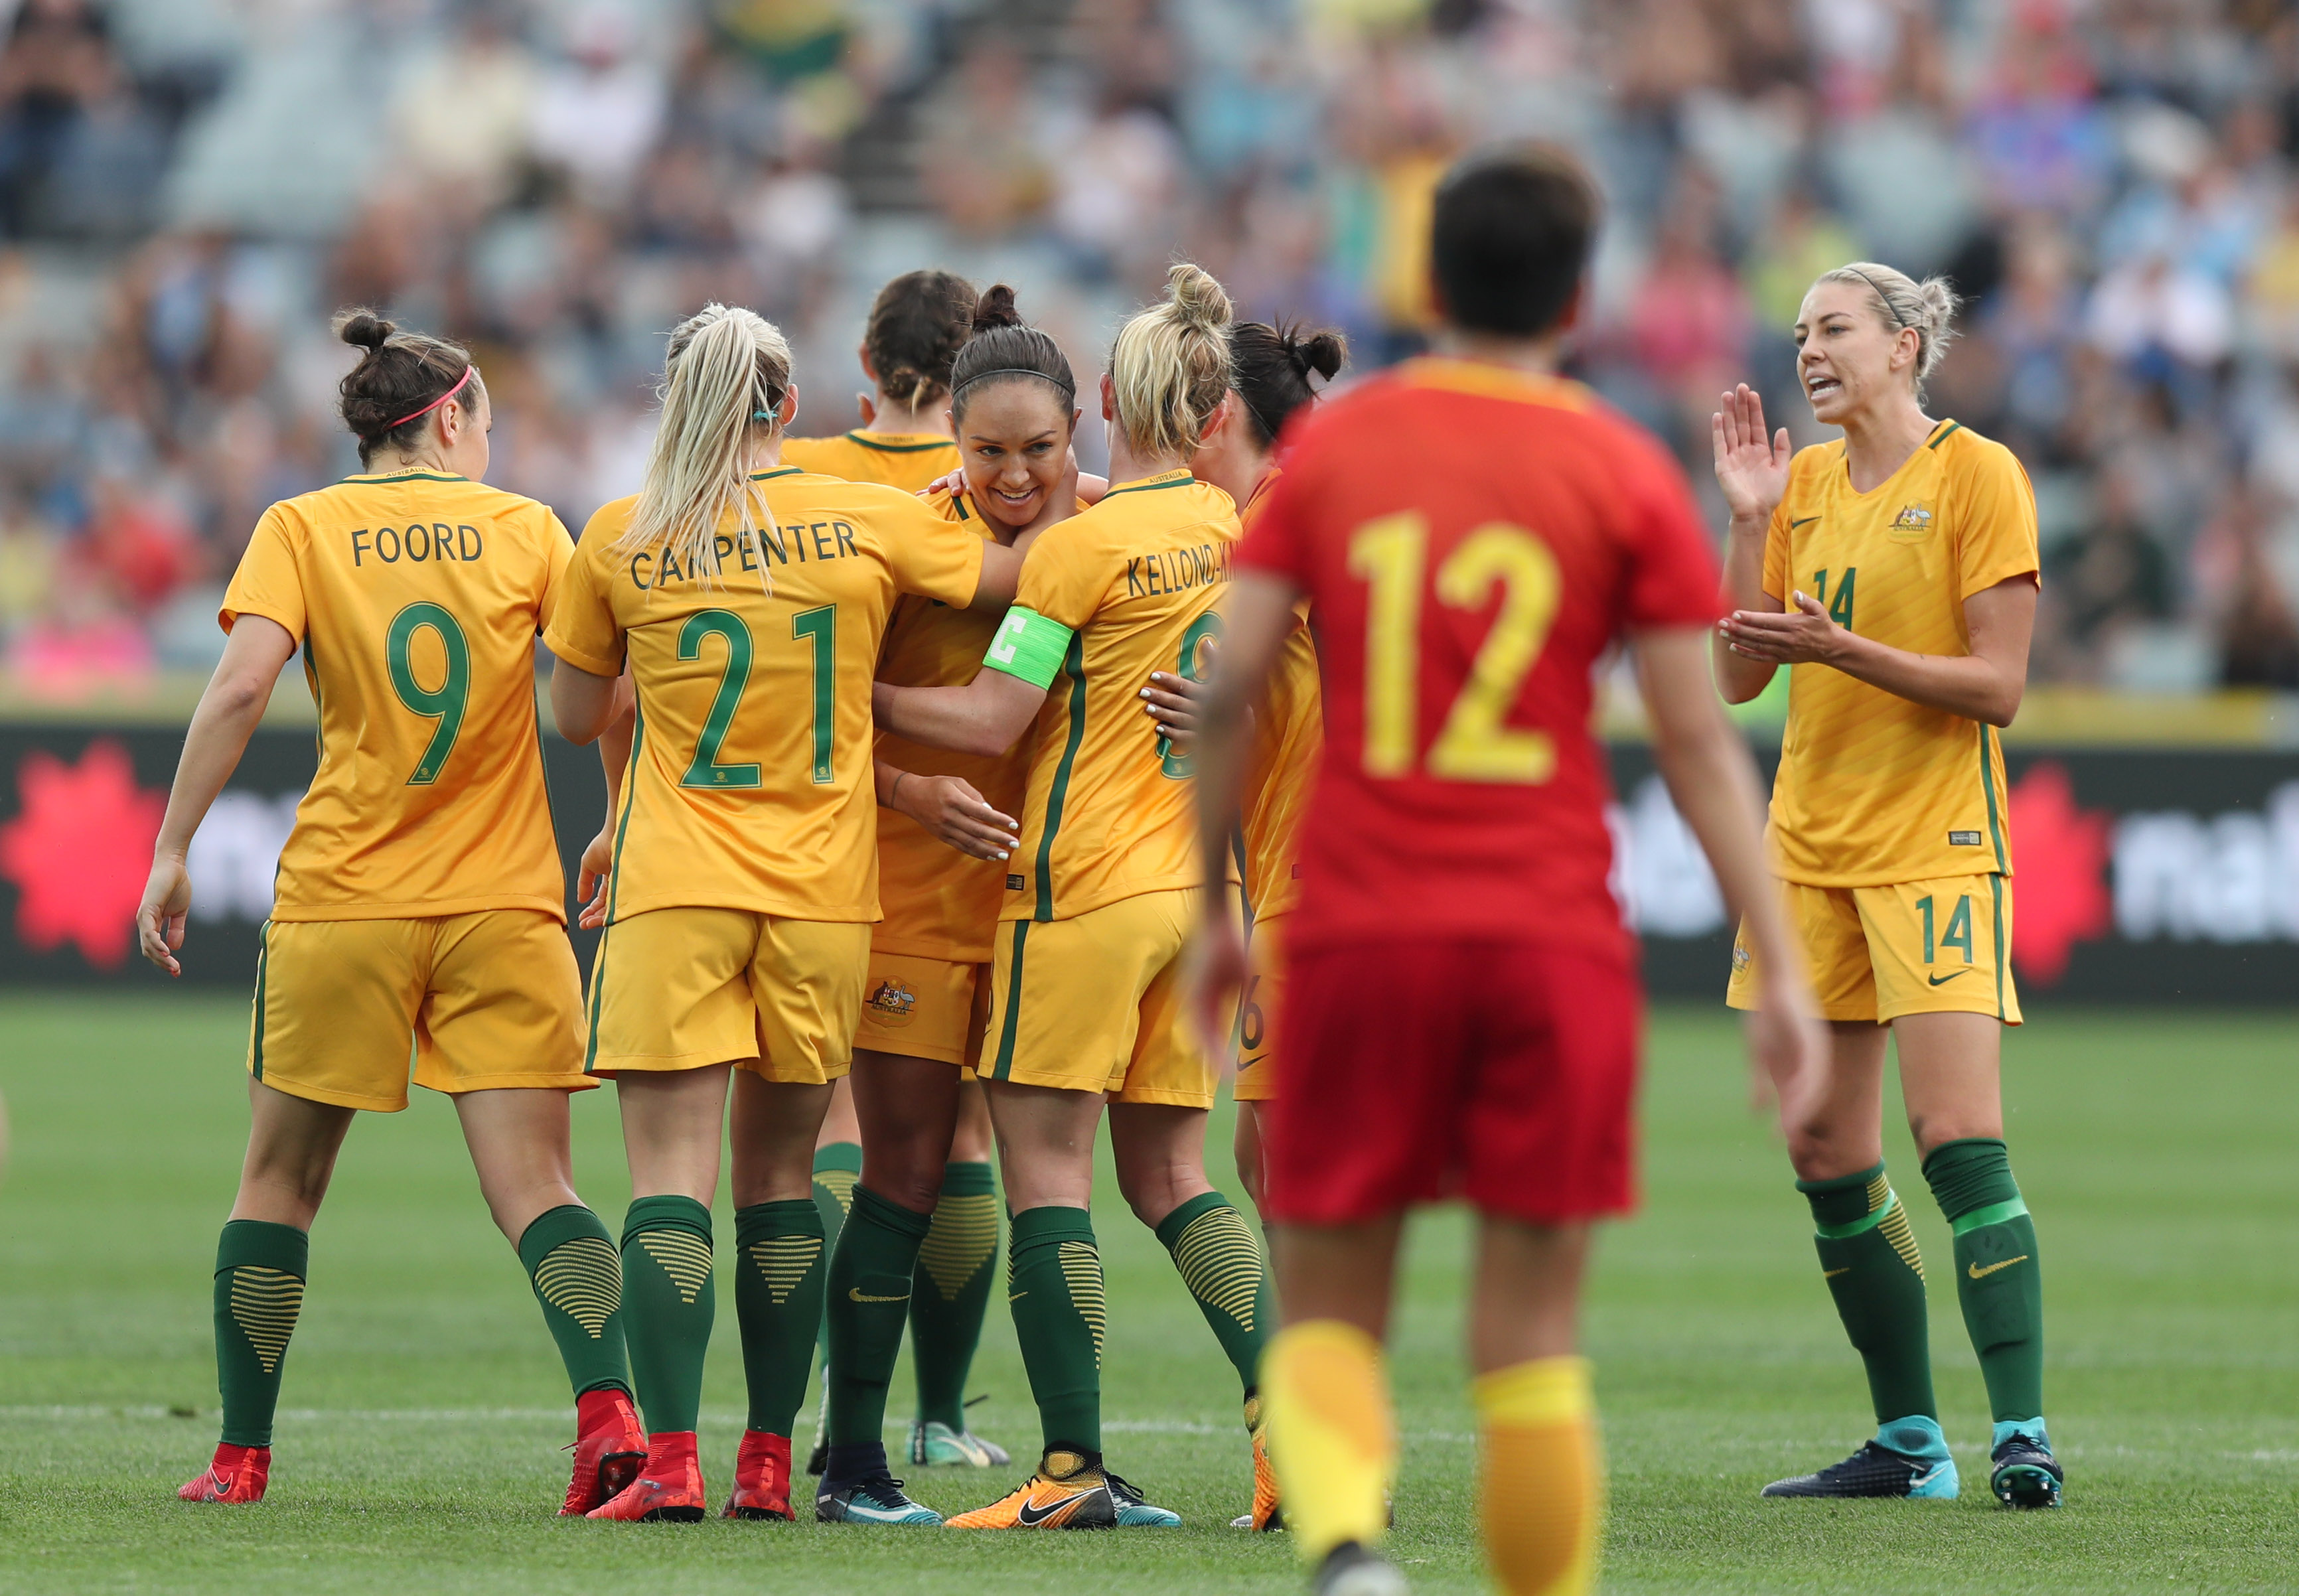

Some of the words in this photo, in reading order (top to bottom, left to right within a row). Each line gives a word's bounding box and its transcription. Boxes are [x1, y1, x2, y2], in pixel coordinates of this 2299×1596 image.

[386, 468, 427, 477] AUSTRALIA
[1149, 471, 1183, 484] AUSTRALIA
[352, 523, 482, 567] FOORD
[630, 522, 858, 590] CARPENTER
[1813, 567, 1856, 632] 14
[990, 614, 1027, 663] C
[1347, 508, 1562, 784] 12
[386, 601, 471, 785] 9
[677, 603, 837, 788] 21
[1915, 894, 1972, 964] 14
[1240, 975, 1264, 1051] 6
